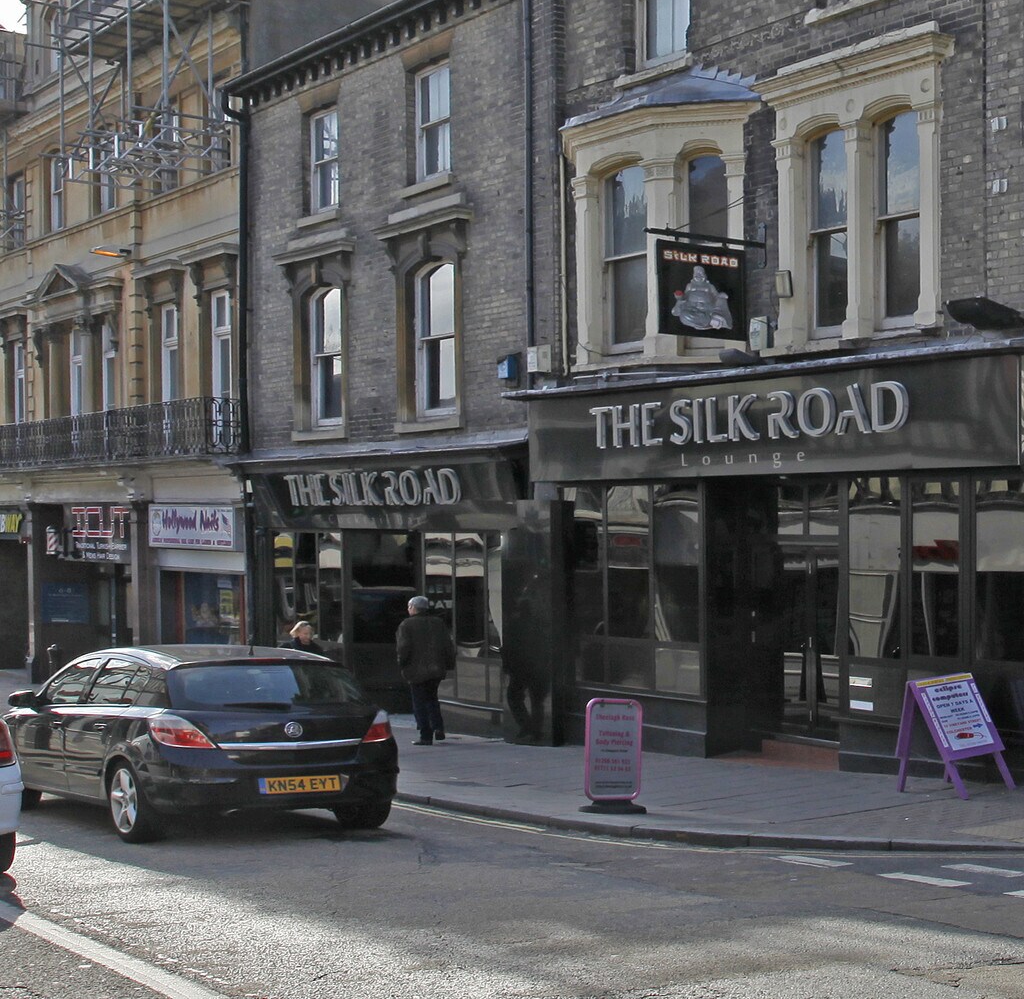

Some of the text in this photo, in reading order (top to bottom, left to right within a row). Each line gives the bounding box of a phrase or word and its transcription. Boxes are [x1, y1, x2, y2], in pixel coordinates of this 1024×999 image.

[700, 254, 739, 269] ROAD
[589, 380, 910, 449] THE SILK ROAD
[680, 450, 806, 469] Lounge
[284, 468, 462, 507] THE SILK ROAD
[162, 508, 219, 535] Hollywood Nails
[267, 777, 337, 792] KN54 EYT
